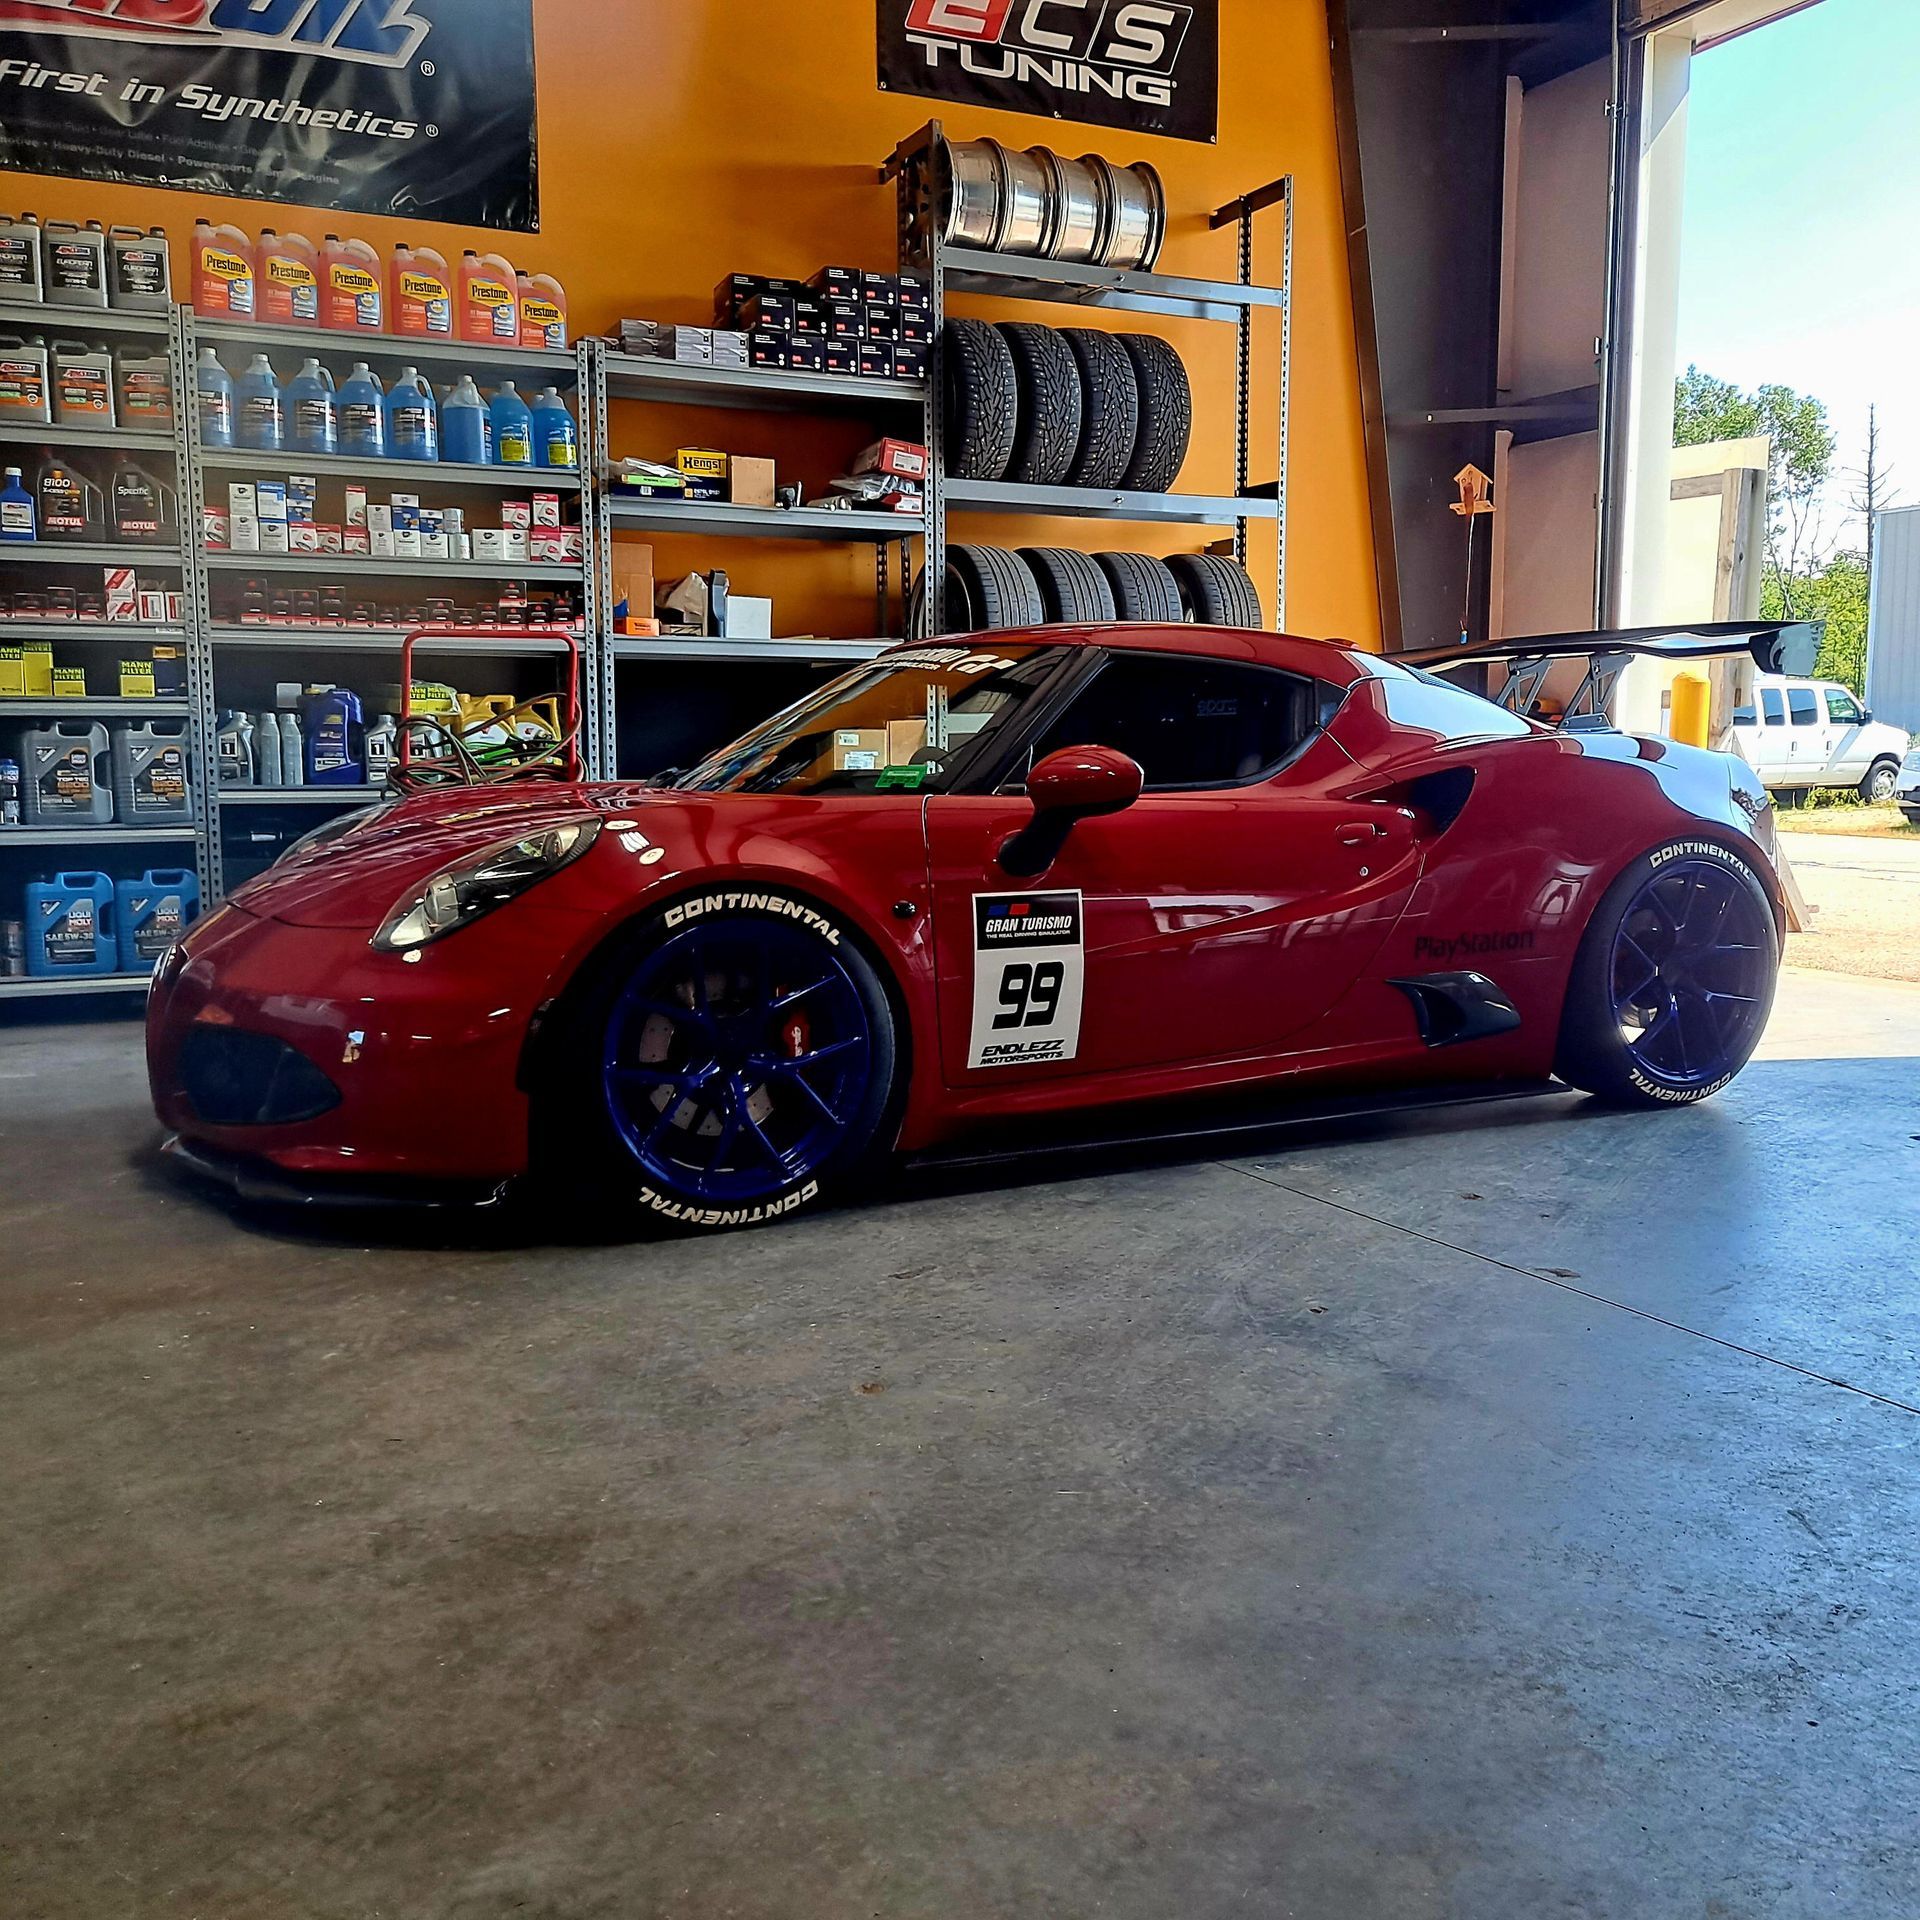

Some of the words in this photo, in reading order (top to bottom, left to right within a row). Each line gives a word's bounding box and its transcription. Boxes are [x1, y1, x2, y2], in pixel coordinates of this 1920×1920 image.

[906, 34, 1171, 107] TUNING
[0, 60, 106, 97] First
[119, 79, 166, 104] in
[176, 85, 418, 140] Synthetics
[207, 254, 246, 274] Prestone
[271, 263, 310, 280] Prestone
[335, 271, 372, 287] Prestone
[405, 279, 441, 294] Prestone
[472, 285, 508, 299] Prestone
[525, 304, 558, 318] Prestone
[43, 478, 71, 488] 8100
[47, 516, 82, 526] MOTUL
[122, 521, 156, 530] MOTUL
[1649, 842, 1750, 880] CONTINENTAL
[68, 918, 92, 926] MOLY
[156, 914, 179, 922] MOLY
[664, 893, 840, 946] CONTINENTAL
[985, 918, 1020, 933] GRAN
[1021, 915, 1073, 931] TURISMO
[45, 933, 64, 942] SAE
[134, 929, 152, 938] SAE
[1038, 929, 1071, 937] SIMULATOR
[1414, 930, 1535, 962] PlayStation
[992, 961, 1065, 1030] 99
[981, 1039, 1065, 1058] ENDLEZZ
[980, 1051, 1064, 1066] MOTORSPORTS
[1629, 1068, 1732, 1101] CONTINENTAL
[638, 1179, 819, 1225] CONTINENTAL
